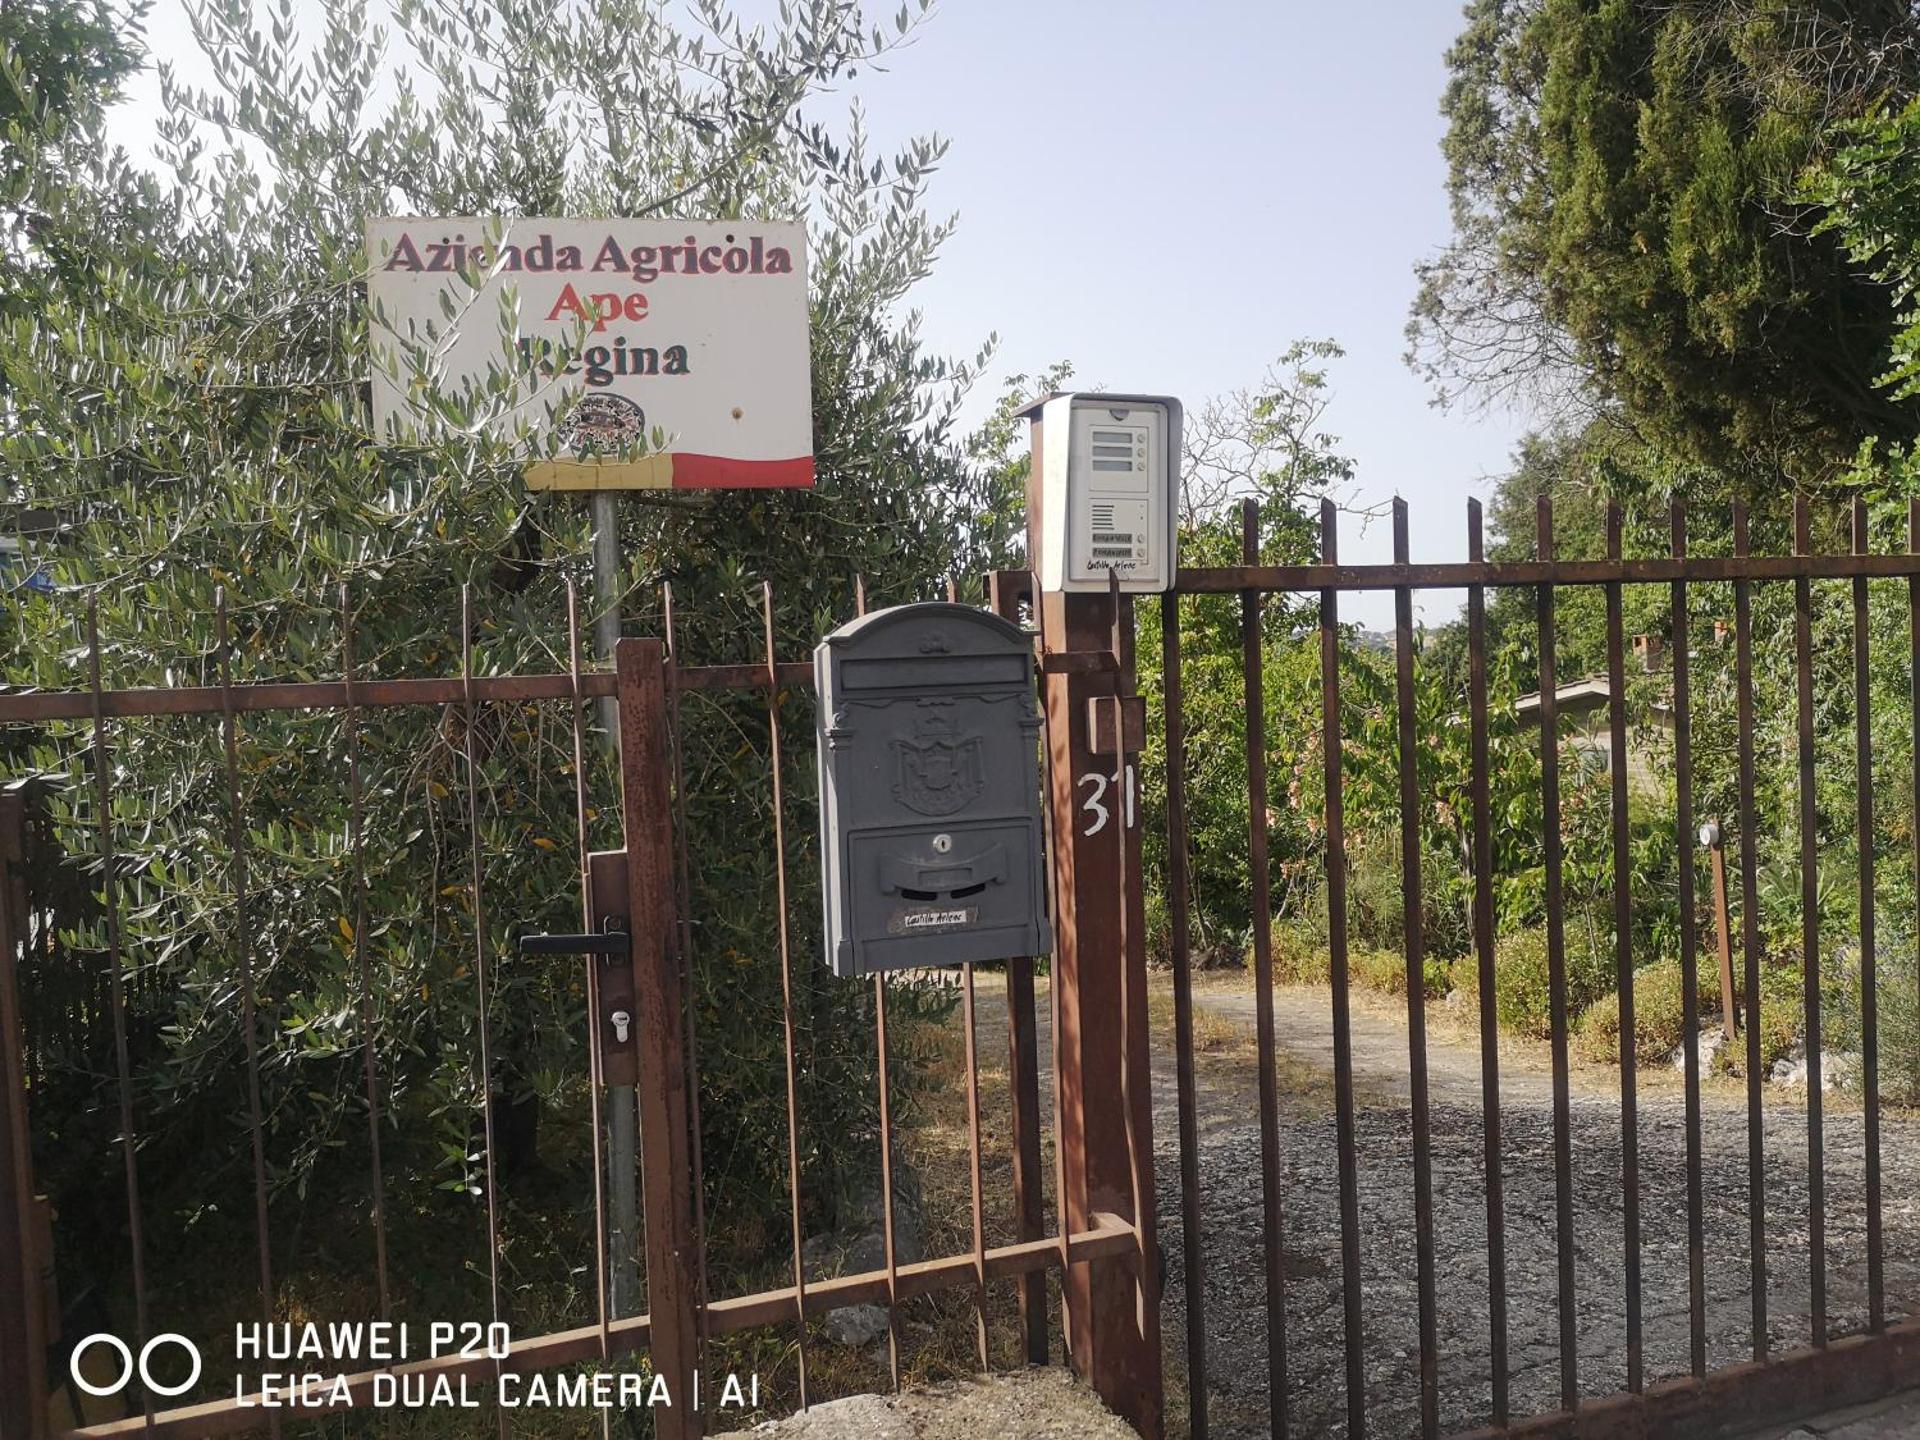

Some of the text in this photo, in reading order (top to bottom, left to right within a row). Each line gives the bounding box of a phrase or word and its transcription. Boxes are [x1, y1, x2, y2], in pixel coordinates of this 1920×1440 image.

[591, 235, 793, 283] Agricola
[545, 283, 649, 331] Ape
[1078, 765, 1135, 836] 31
